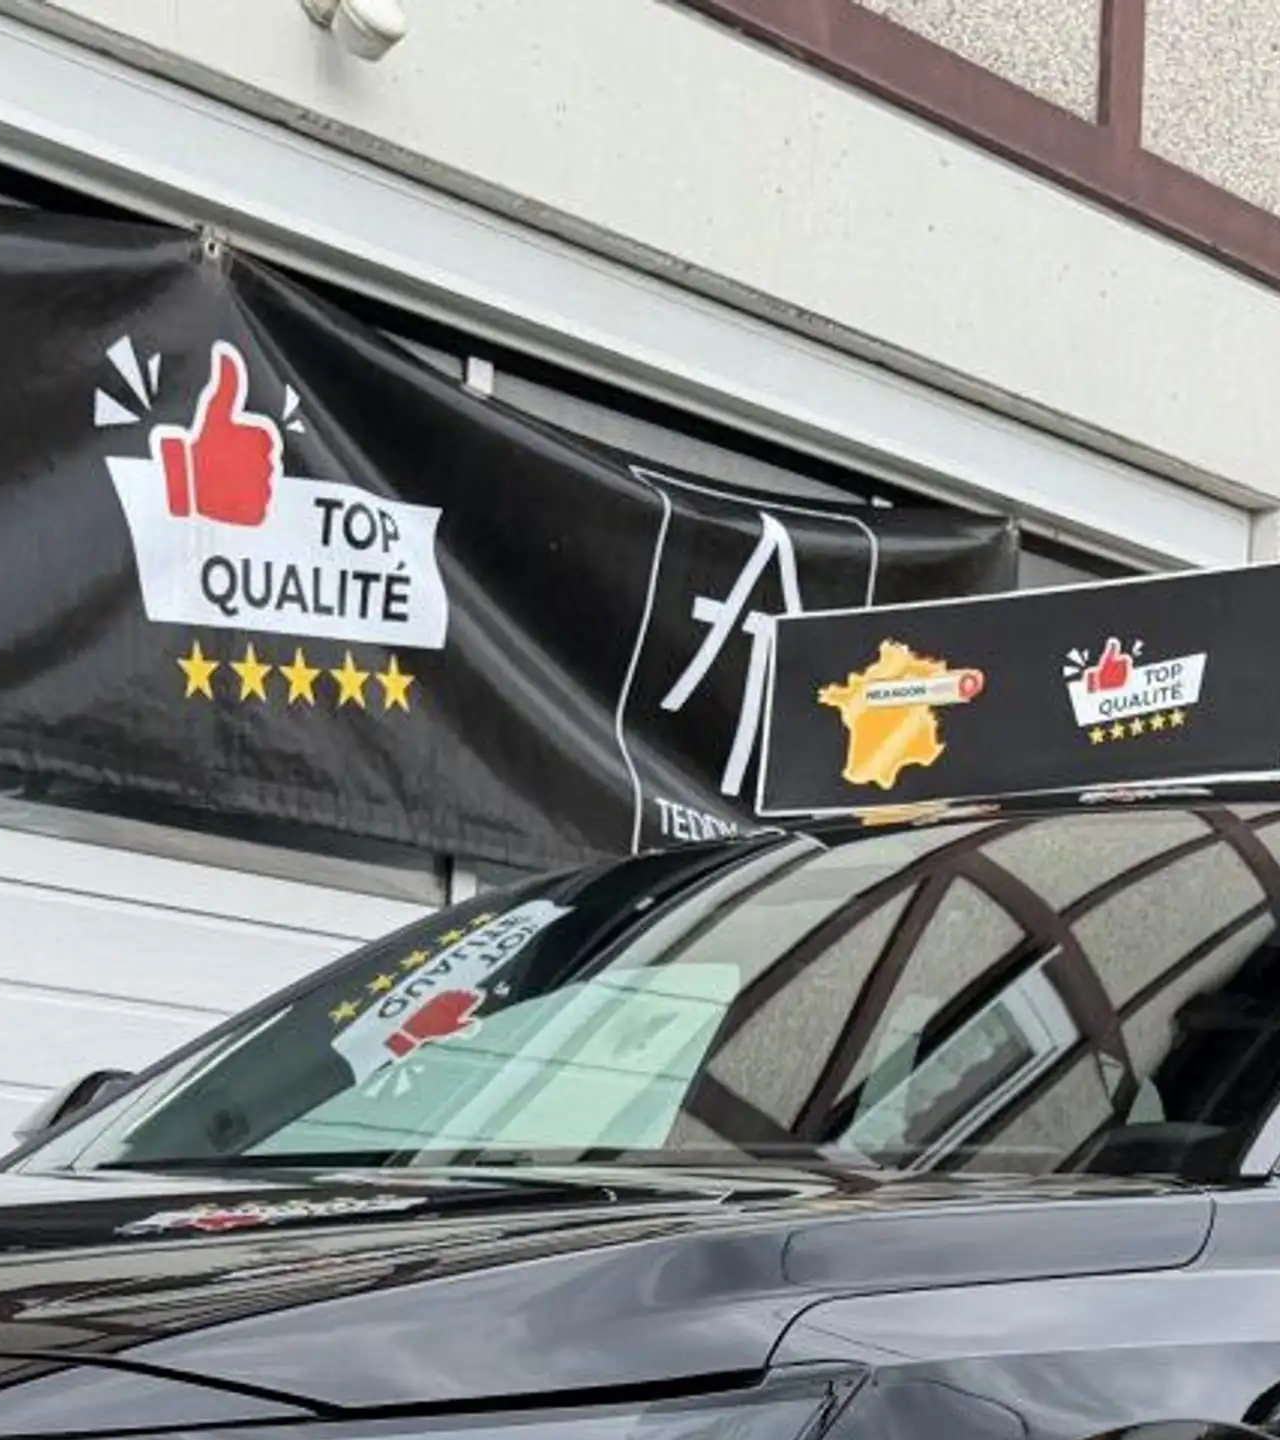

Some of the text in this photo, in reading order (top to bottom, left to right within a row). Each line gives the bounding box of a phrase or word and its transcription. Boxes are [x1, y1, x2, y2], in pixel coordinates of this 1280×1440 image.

[314, 497, 401, 553] TOP
[201, 554, 411, 622] QUALITÉ
[1144, 662, 1184, 686] TOP
[1098, 680, 1184, 717] QUALITÉ
